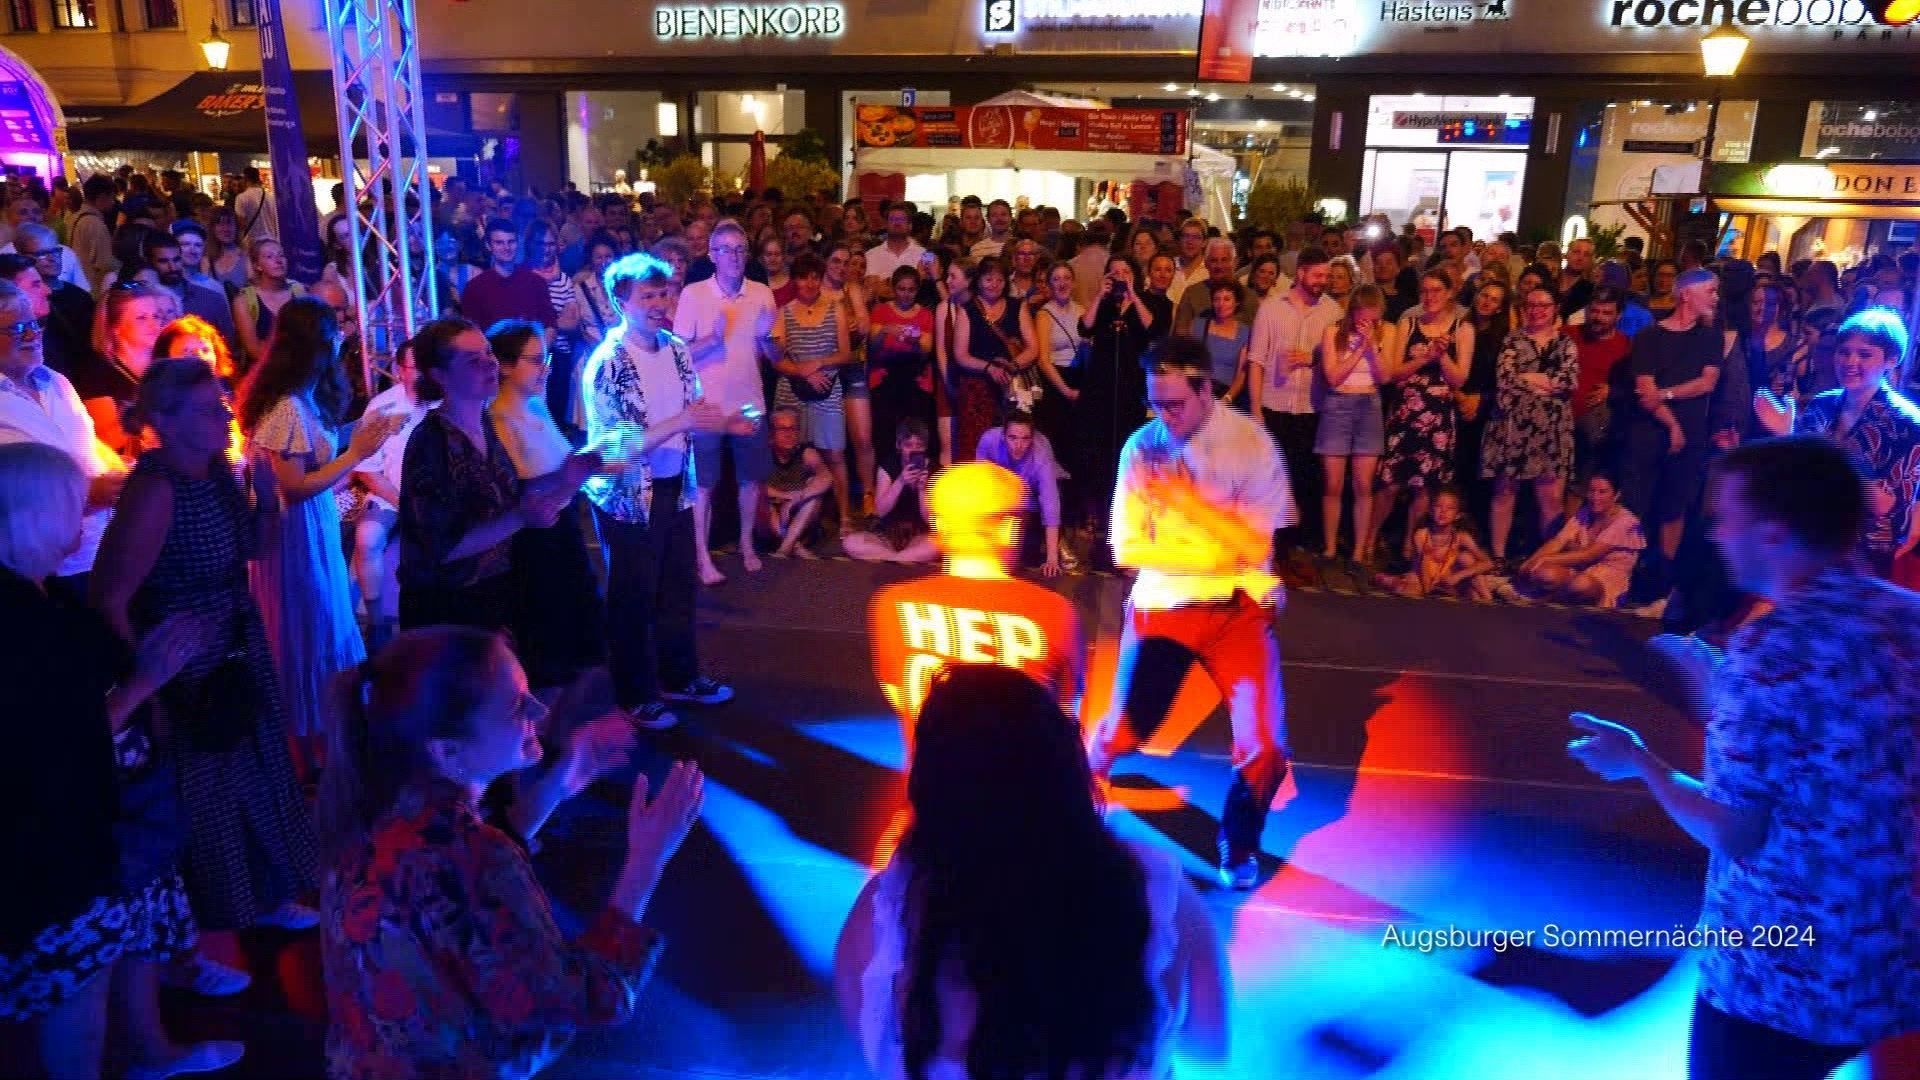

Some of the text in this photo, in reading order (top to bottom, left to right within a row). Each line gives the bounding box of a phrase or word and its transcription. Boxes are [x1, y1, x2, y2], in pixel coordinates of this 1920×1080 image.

[655, 6, 842, 36] BIENENKORB
[1380, 0, 1472, 22] Hästens
[1609, 0, 1915, 27] rochebob
[895, 601, 1048, 669] HEP
